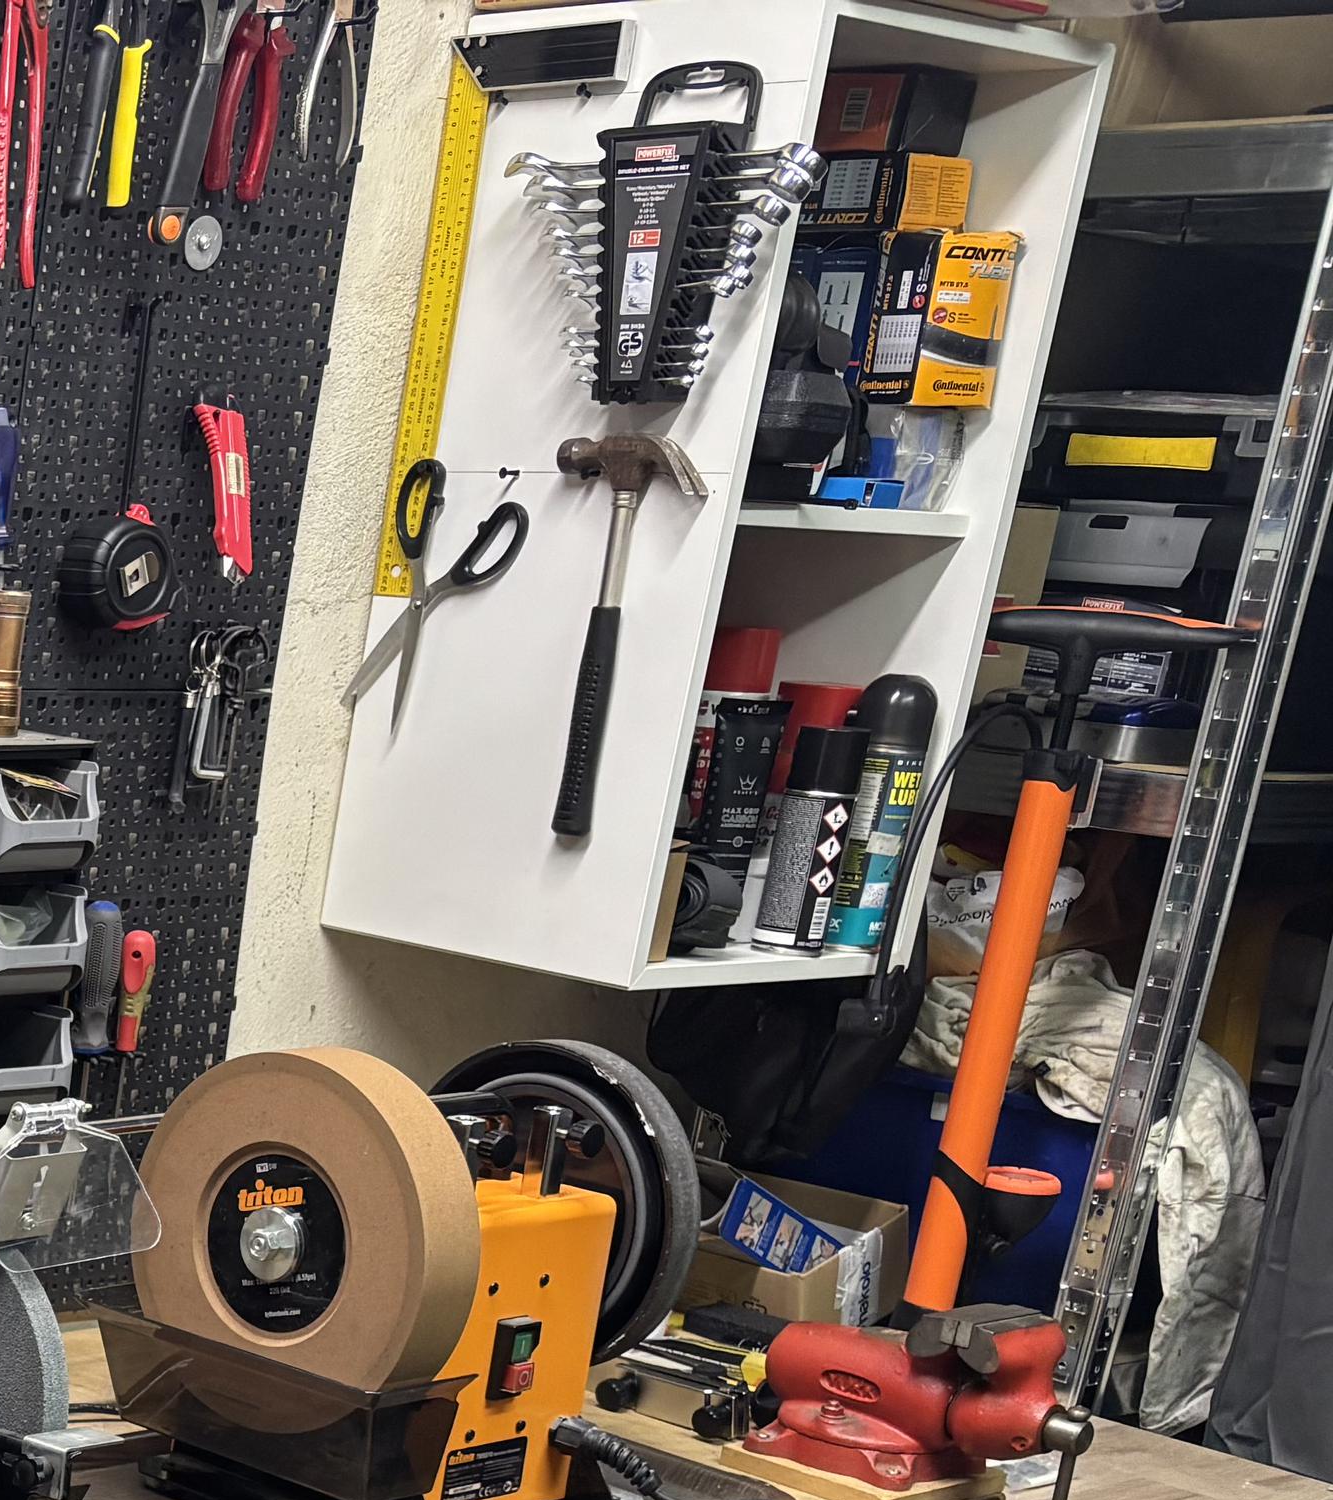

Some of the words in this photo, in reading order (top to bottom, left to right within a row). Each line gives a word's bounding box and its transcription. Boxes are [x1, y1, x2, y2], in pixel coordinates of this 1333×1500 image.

[632, 232, 645, 245] 12
[860, 380, 902, 392] Continental
[933, 380, 978, 393] Continental
[722, 807, 742, 815] MAX
[238, 1179, 304, 1212] triton
